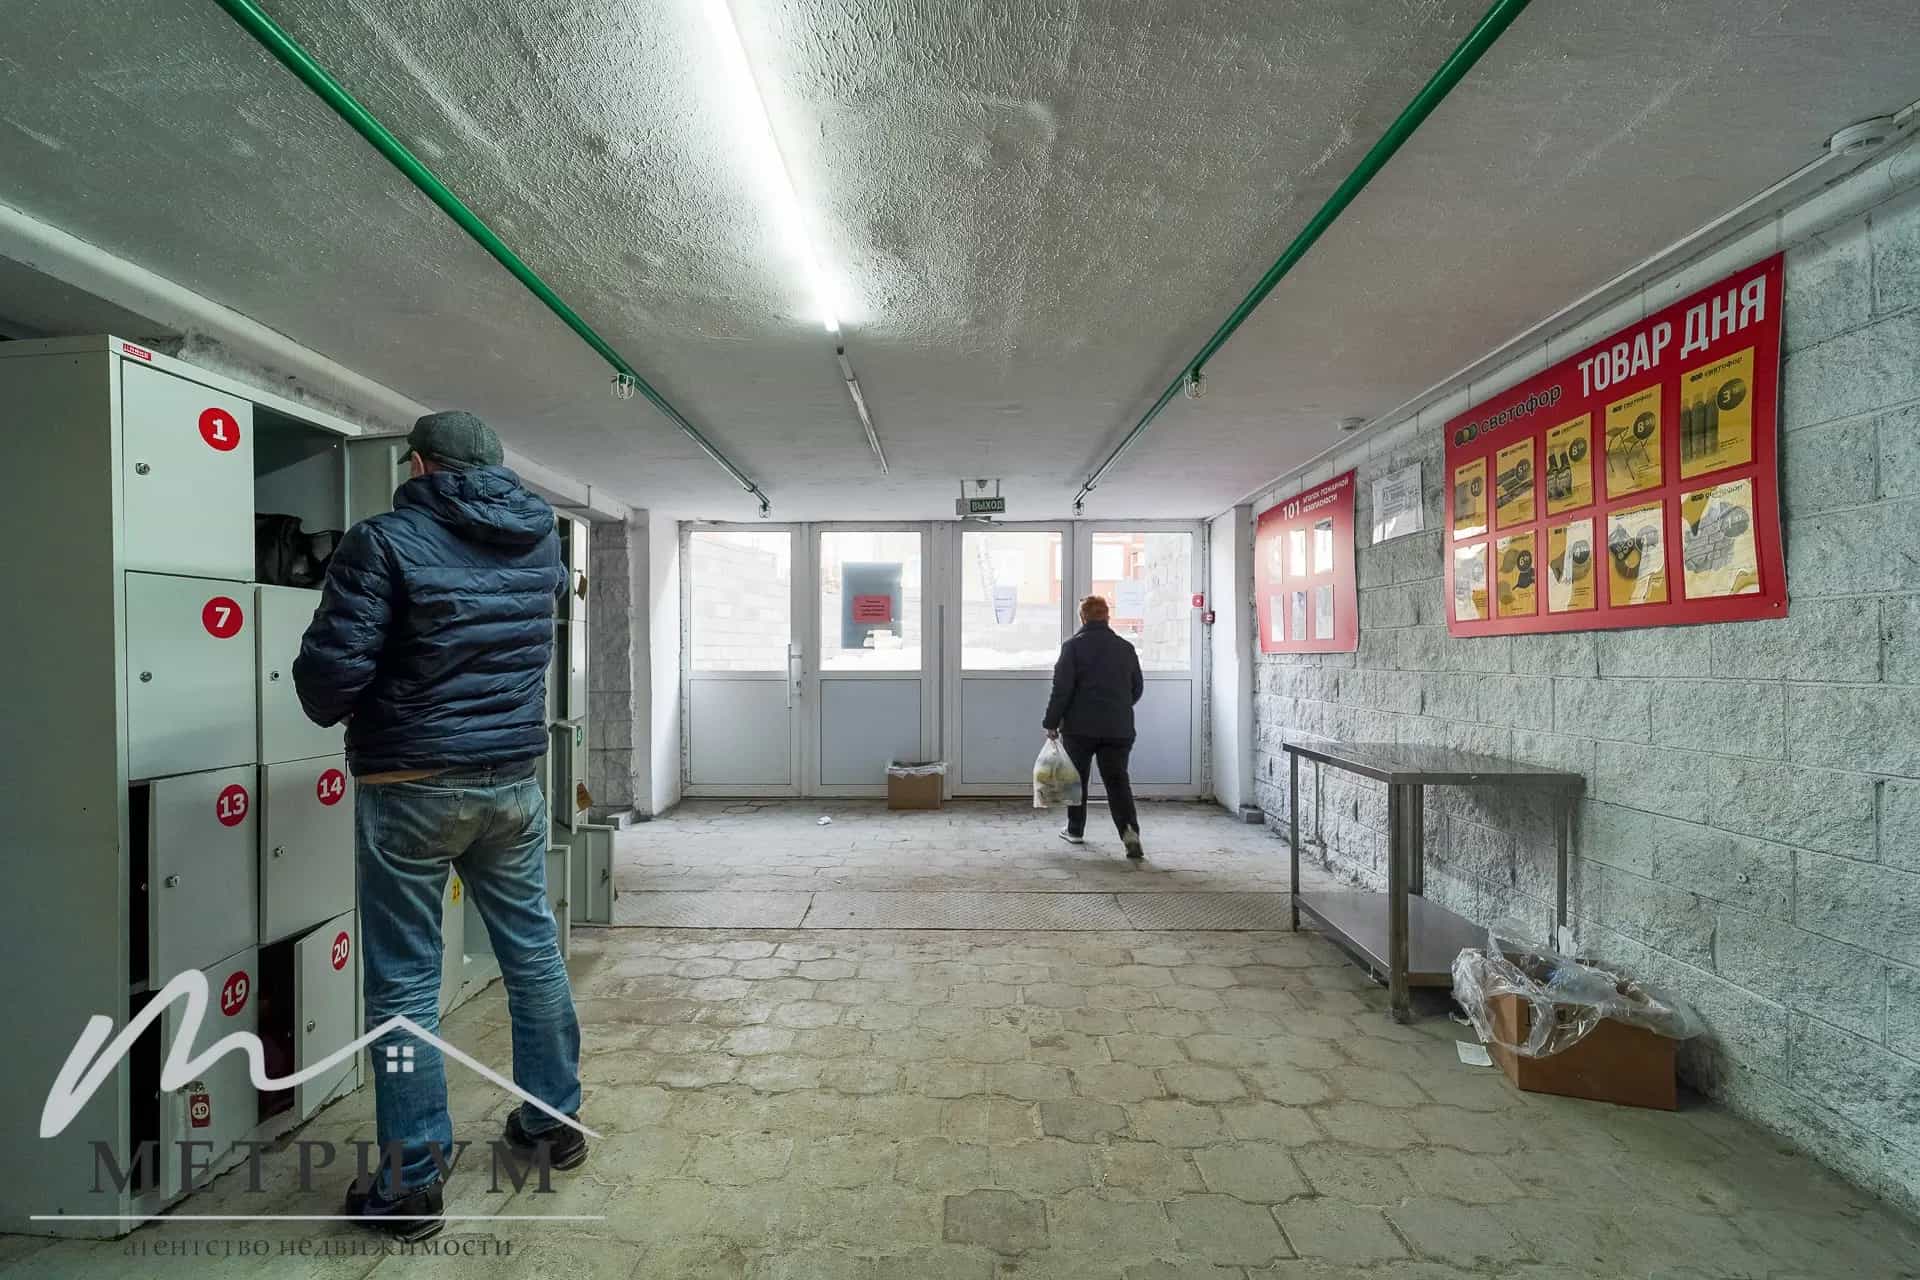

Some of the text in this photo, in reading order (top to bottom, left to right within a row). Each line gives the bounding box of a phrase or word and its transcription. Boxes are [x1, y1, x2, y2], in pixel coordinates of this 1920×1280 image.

[1578, 274, 1767, 398] ТОВАР ДНЯ
[212, 419, 228, 442] 1
[971, 500, 1003, 511] ВЫХОД
[1283, 499, 1300, 521] 101
[215, 606, 231, 629] 7
[319, 776, 344, 799] 14
[220, 793, 246, 818] 13
[334, 938, 349, 965] 20
[224, 979, 247, 1010] 19
[194, 1104, 207, 1116] 19
